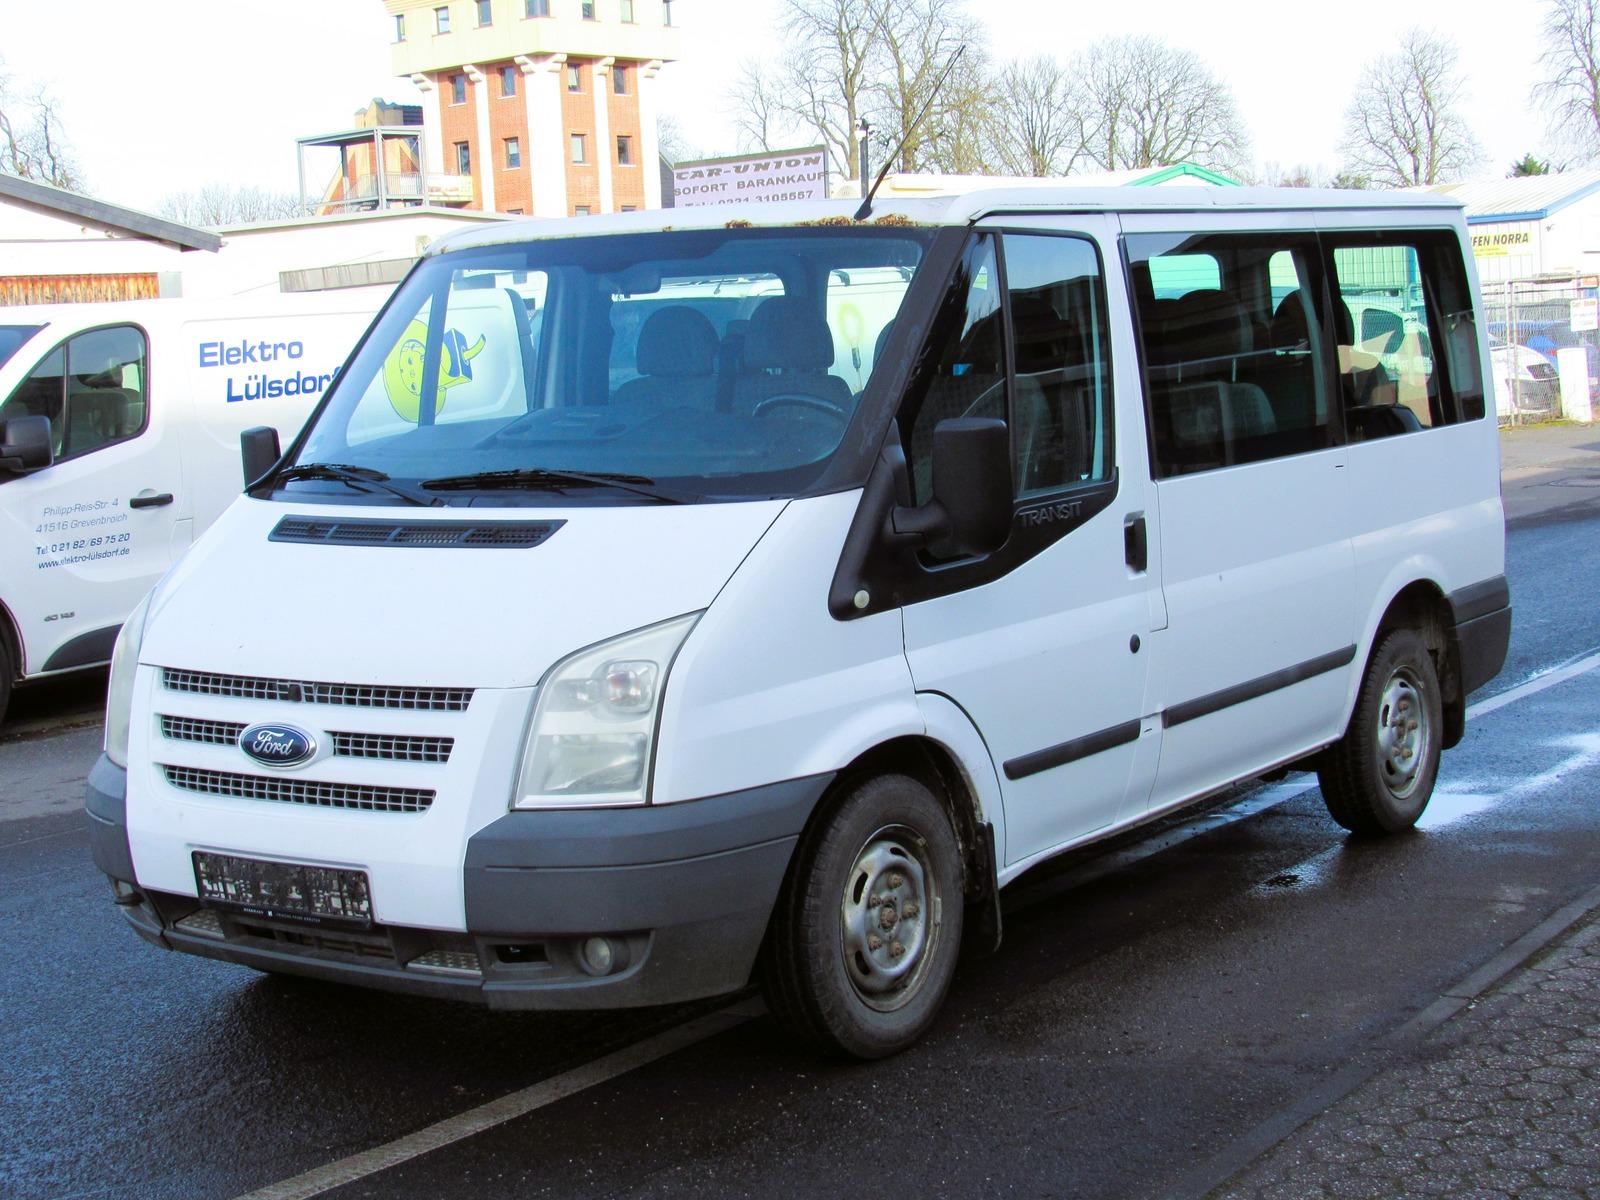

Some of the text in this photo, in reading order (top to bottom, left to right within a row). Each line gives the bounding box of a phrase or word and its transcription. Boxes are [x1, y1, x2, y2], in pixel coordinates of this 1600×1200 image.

[674, 172, 825, 196] SOFORT BARANKAUF
[1471, 233, 1529, 247] FEN NORRA
[199, 339, 303, 368] Elektro
[35, 513, 128, 533] 41516 Grevenbroich
[1018, 501, 1082, 527] TRANSIT
[51, 544, 57, 553] 0
[59, 542, 70, 552] 21
[105, 535, 116, 545] 75
[117, 533, 130, 543] 20
[252, 730, 294, 755] Ford
